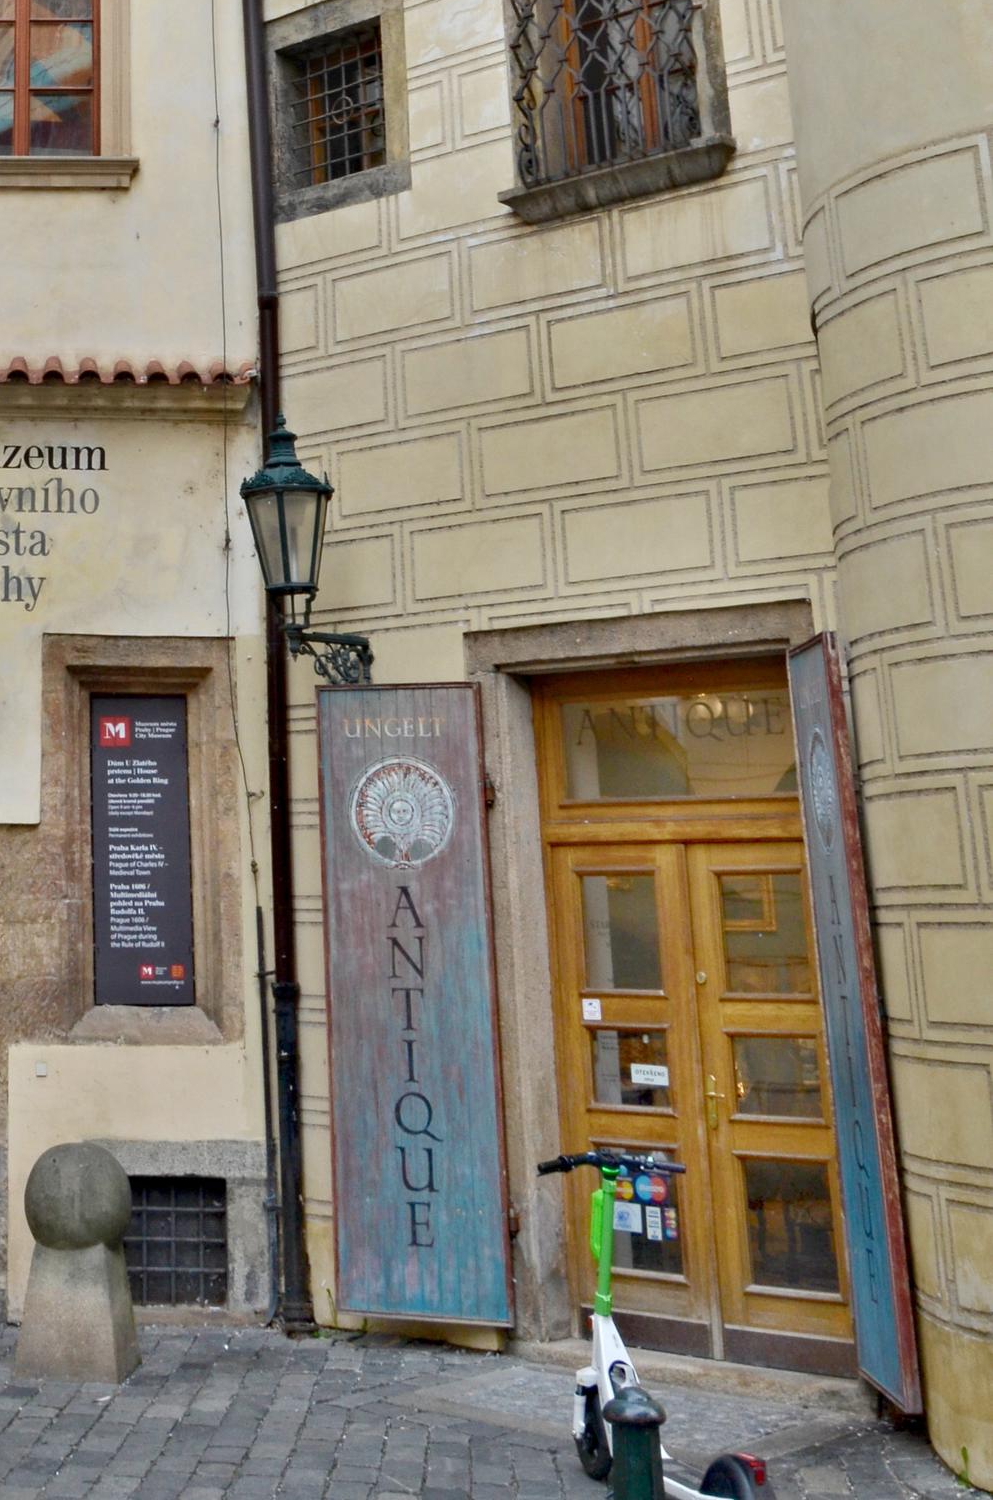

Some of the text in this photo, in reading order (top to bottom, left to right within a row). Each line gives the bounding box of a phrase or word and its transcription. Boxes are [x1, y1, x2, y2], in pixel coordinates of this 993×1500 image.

[103, 722, 126, 739] M
[343, 716, 446, 739] UNGELT
[577, 698, 785, 747] ANTIQUE
[153, 777, 169, 785] Ring
[387, 884, 443, 1250] ANTIQUE
